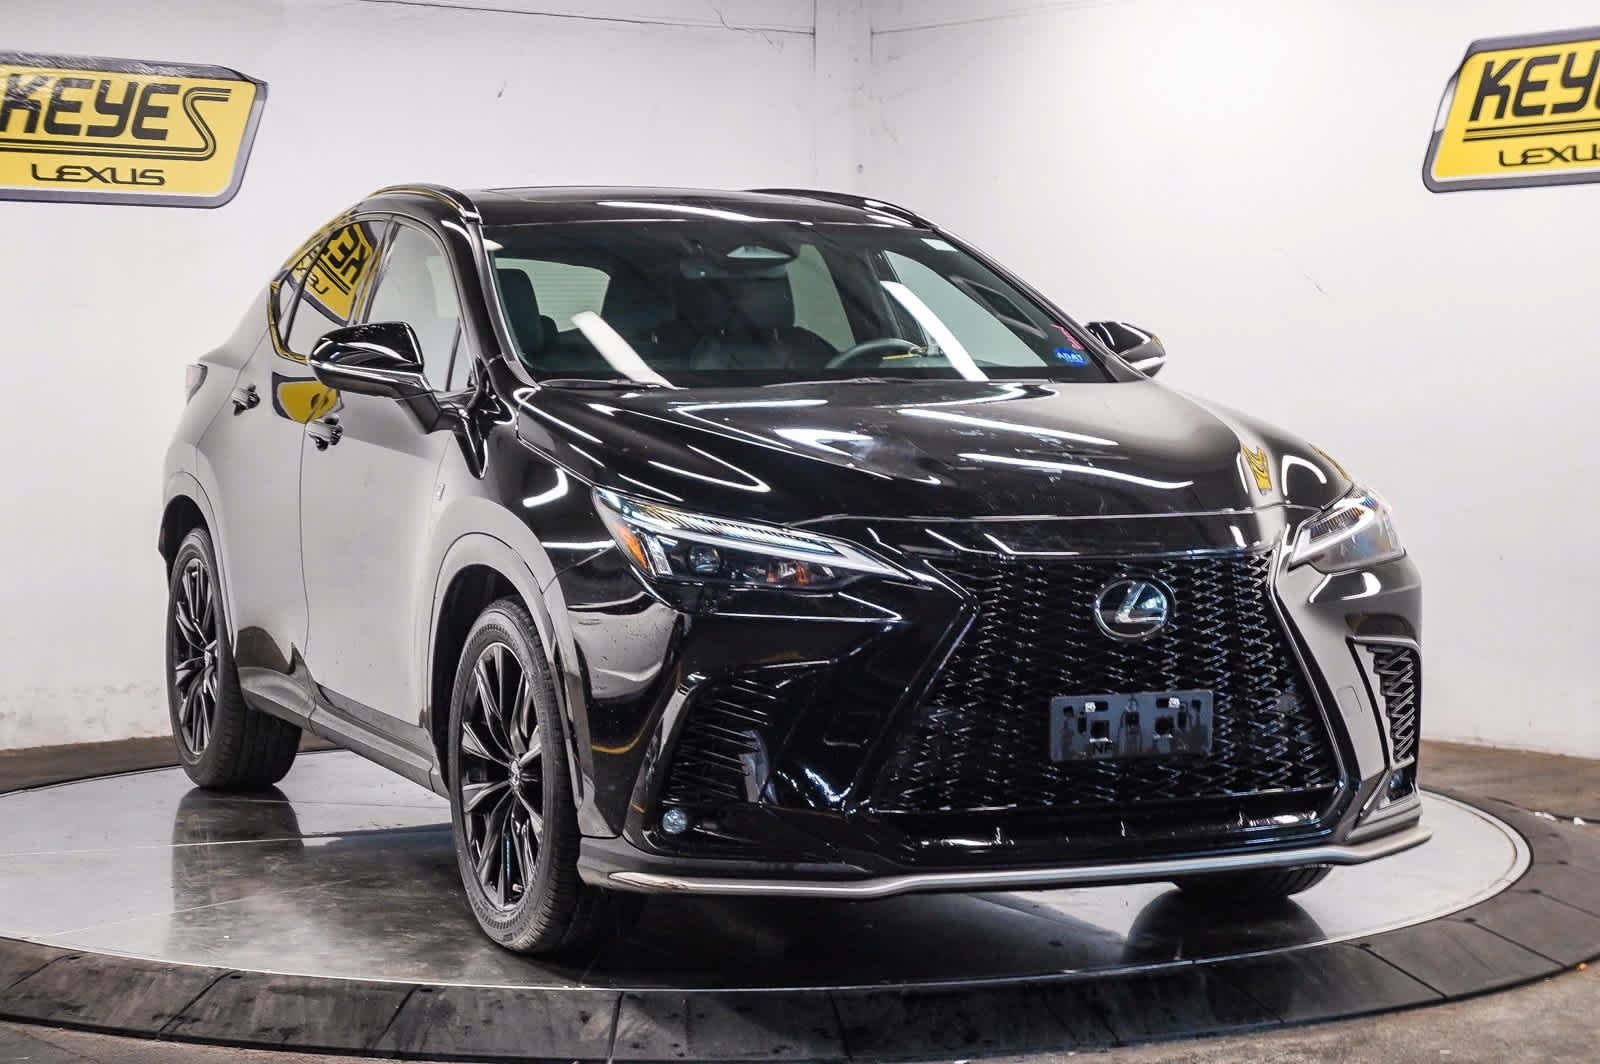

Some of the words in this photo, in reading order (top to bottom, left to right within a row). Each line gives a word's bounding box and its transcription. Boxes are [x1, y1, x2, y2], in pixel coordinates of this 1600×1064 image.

[1469, 50, 1600, 122] KEY
[0, 73, 232, 161] KEYES
[31, 163, 166, 185] LEXUS
[1499, 144, 1600, 167] LEXU
